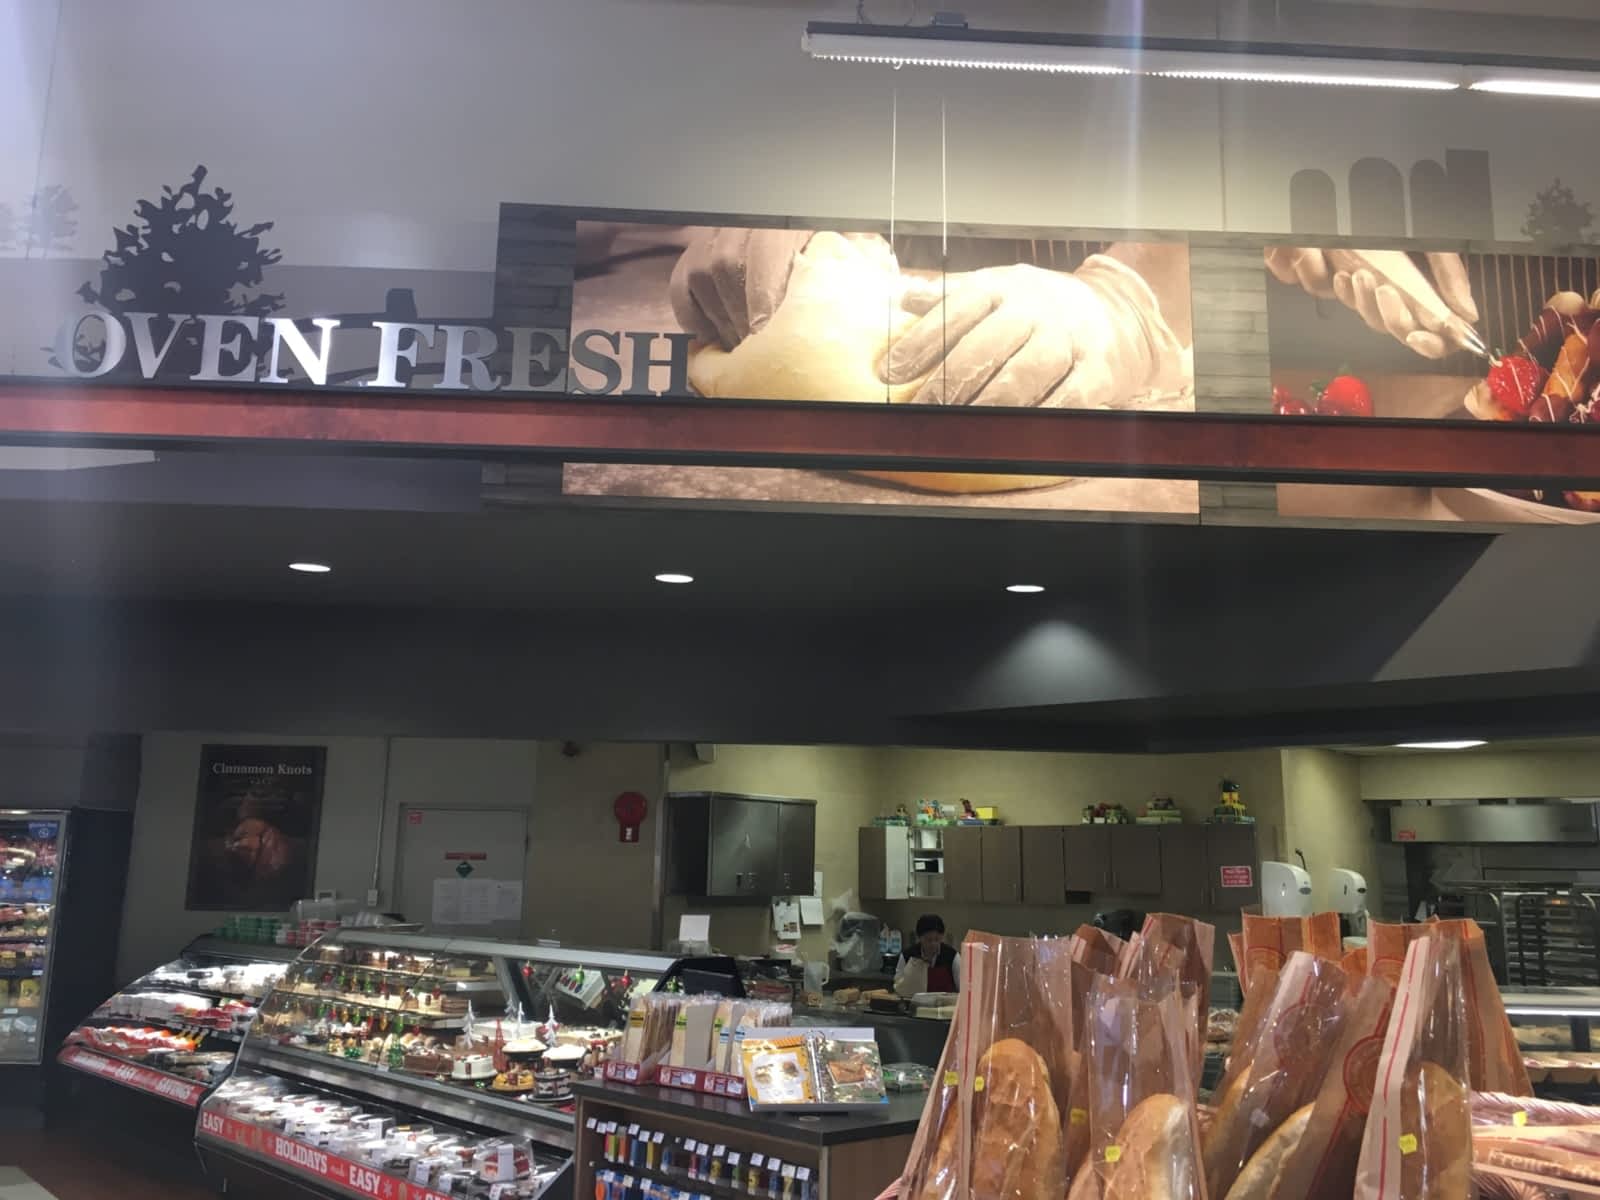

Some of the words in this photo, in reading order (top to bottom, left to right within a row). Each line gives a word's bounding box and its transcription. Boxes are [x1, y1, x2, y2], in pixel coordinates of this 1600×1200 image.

[56, 309, 341, 387] OVEN
[366, 320, 695, 397] FRESH
[212, 762, 274, 775] Cinnamon
[277, 763, 312, 775] Knots
[202, 1112, 224, 1134] EASY
[275, 1137, 328, 1175] HOLIDAYS
[350, 1165, 381, 1195] EASY
